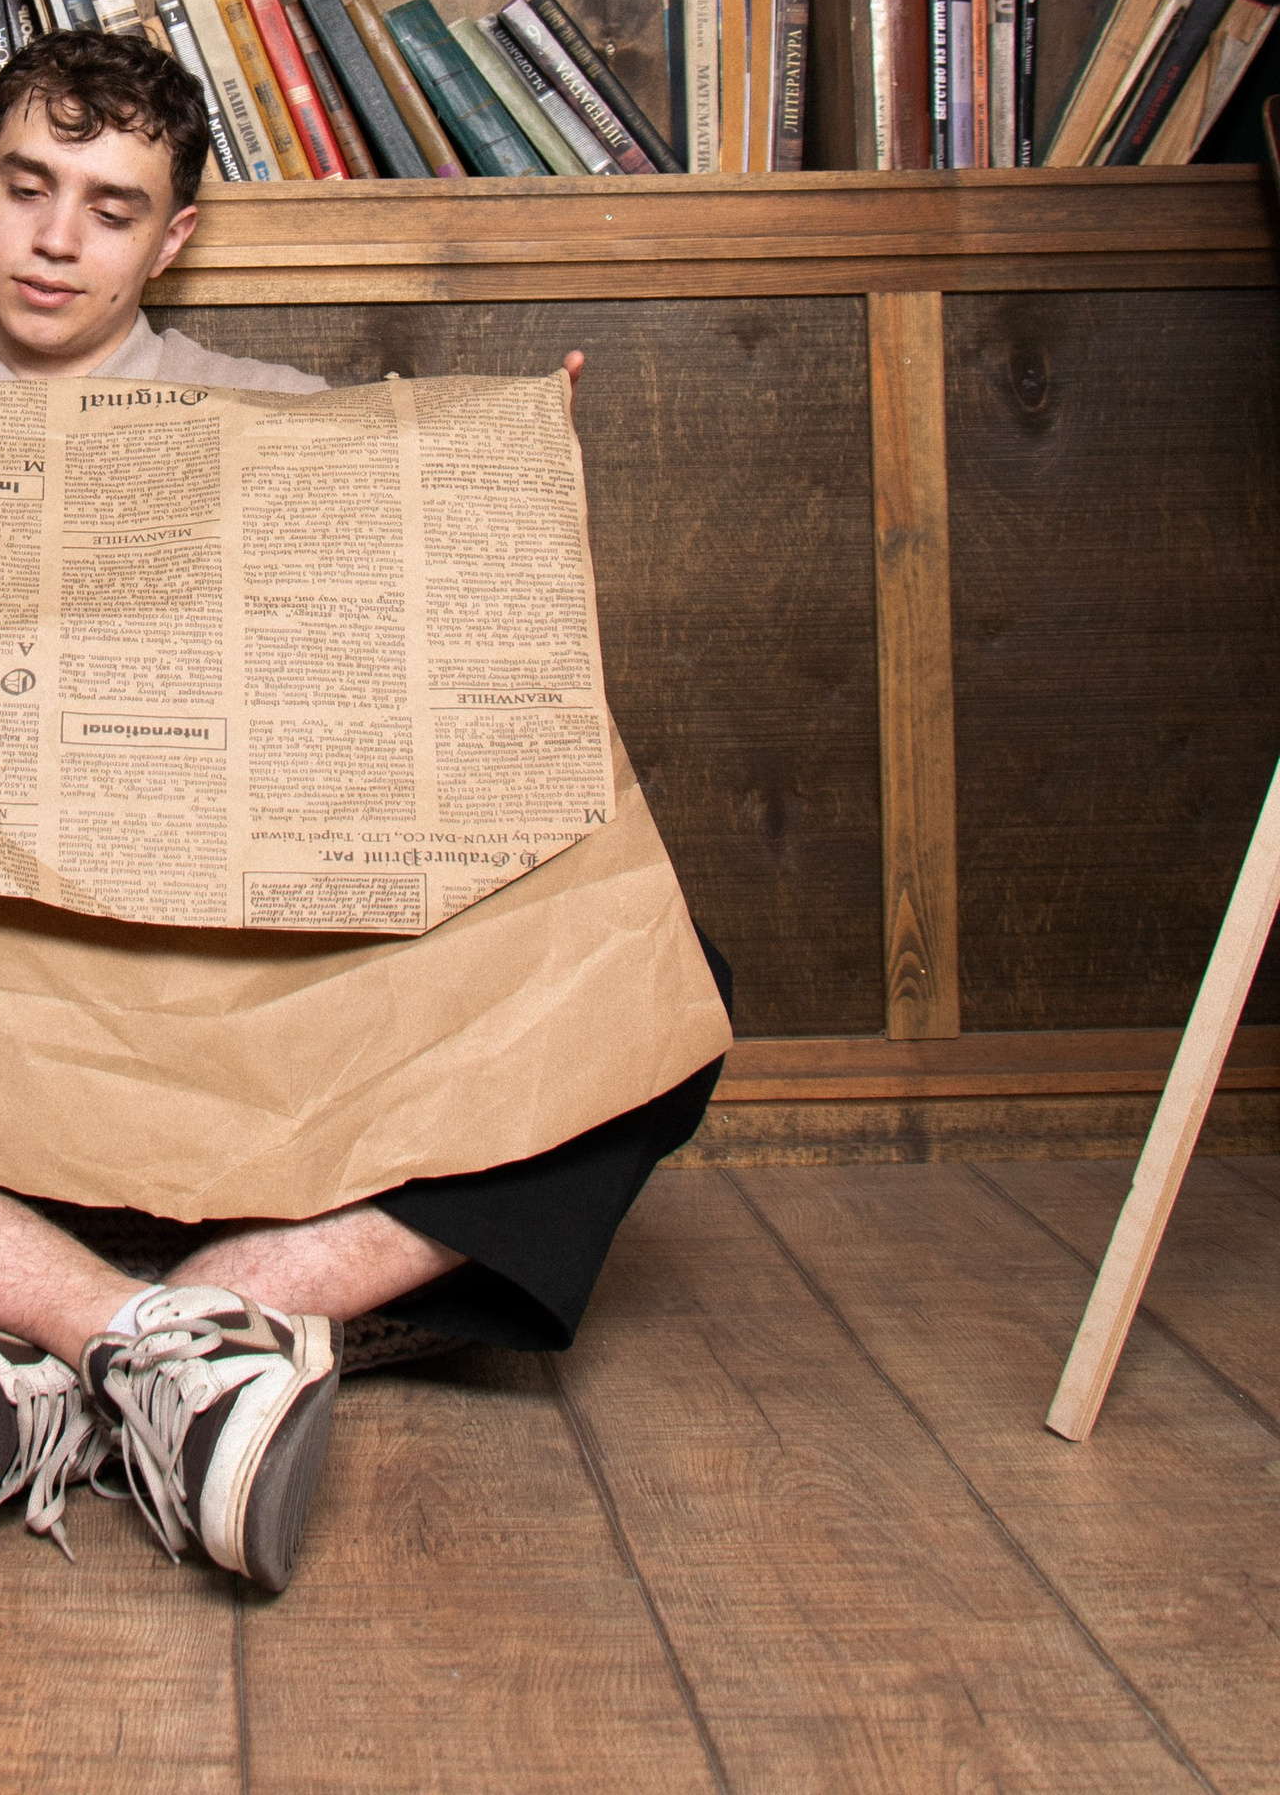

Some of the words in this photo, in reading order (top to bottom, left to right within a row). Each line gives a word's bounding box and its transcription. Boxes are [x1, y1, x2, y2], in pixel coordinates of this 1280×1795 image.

[933, 0, 946, 43] ЕГИПТА
[494, 27, 546, 92] М.ГОРЬКИЙ
[935, 48, 946, 63] ИЗ
[782, 28, 802, 131] ЛИТЕРАТУРА
[935, 67, 947, 119] БЕГСТВО
[552, 59, 629, 150] ЛИТЕРАТУРА
[221, 77, 247, 118] НАШ
[236, 118, 262, 155] ДОМ
[695, 65, 713, 173] МАТЕМАТИК
[79, 388, 208, 413] Original
[92, 529, 192, 544] MEANWHILE
[245, 609, 278, 617] Valerie
[338, 612, 369, 621] whole
[457, 693, 563, 705] MEANWHILE
[83, 724, 209, 740] International
[251, 831, 304, 842] Taiwan
[309, 828, 353, 842] Taipei
[358, 831, 390, 842] LTD.
[394, 831, 424, 842] CO.,
[430, 832, 507, 843] HYUN-DAI
[512, 829, 530, 843] by
[318, 851, 354, 861] PAT.
[251, 916, 280, 924] should
[282, 915, 333, 924] publication
[335, 916, 348, 924] for
[349, 916, 388, 924] intended
